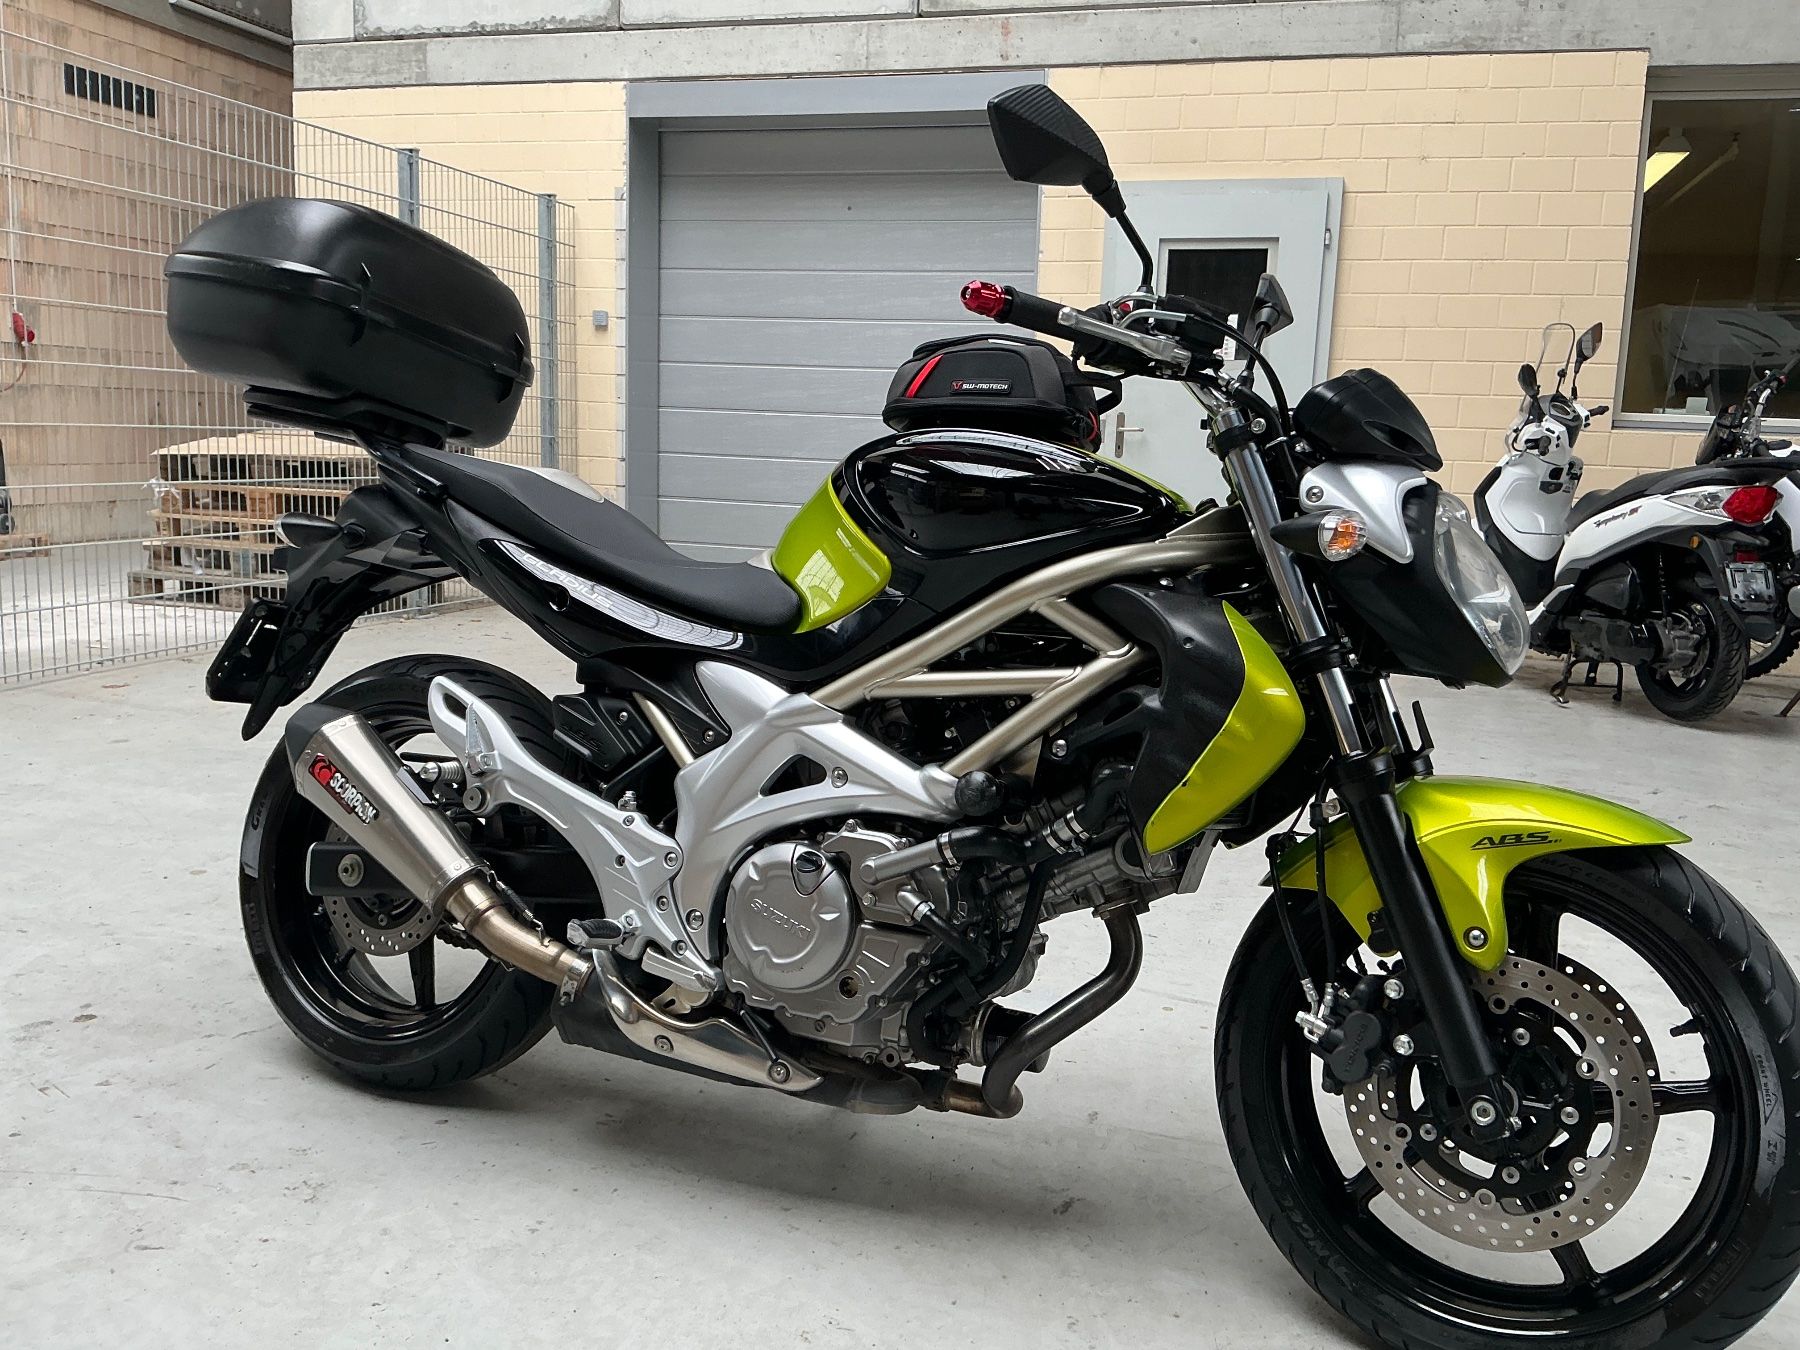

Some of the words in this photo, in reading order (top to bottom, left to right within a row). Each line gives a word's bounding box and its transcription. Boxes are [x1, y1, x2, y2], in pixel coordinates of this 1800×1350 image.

[521, 553, 614, 609] GLADIUS
[330, 772, 377, 823] SCORPION
[1470, 831, 1552, 851] ABS
[750, 898, 812, 939] SUZUKI
